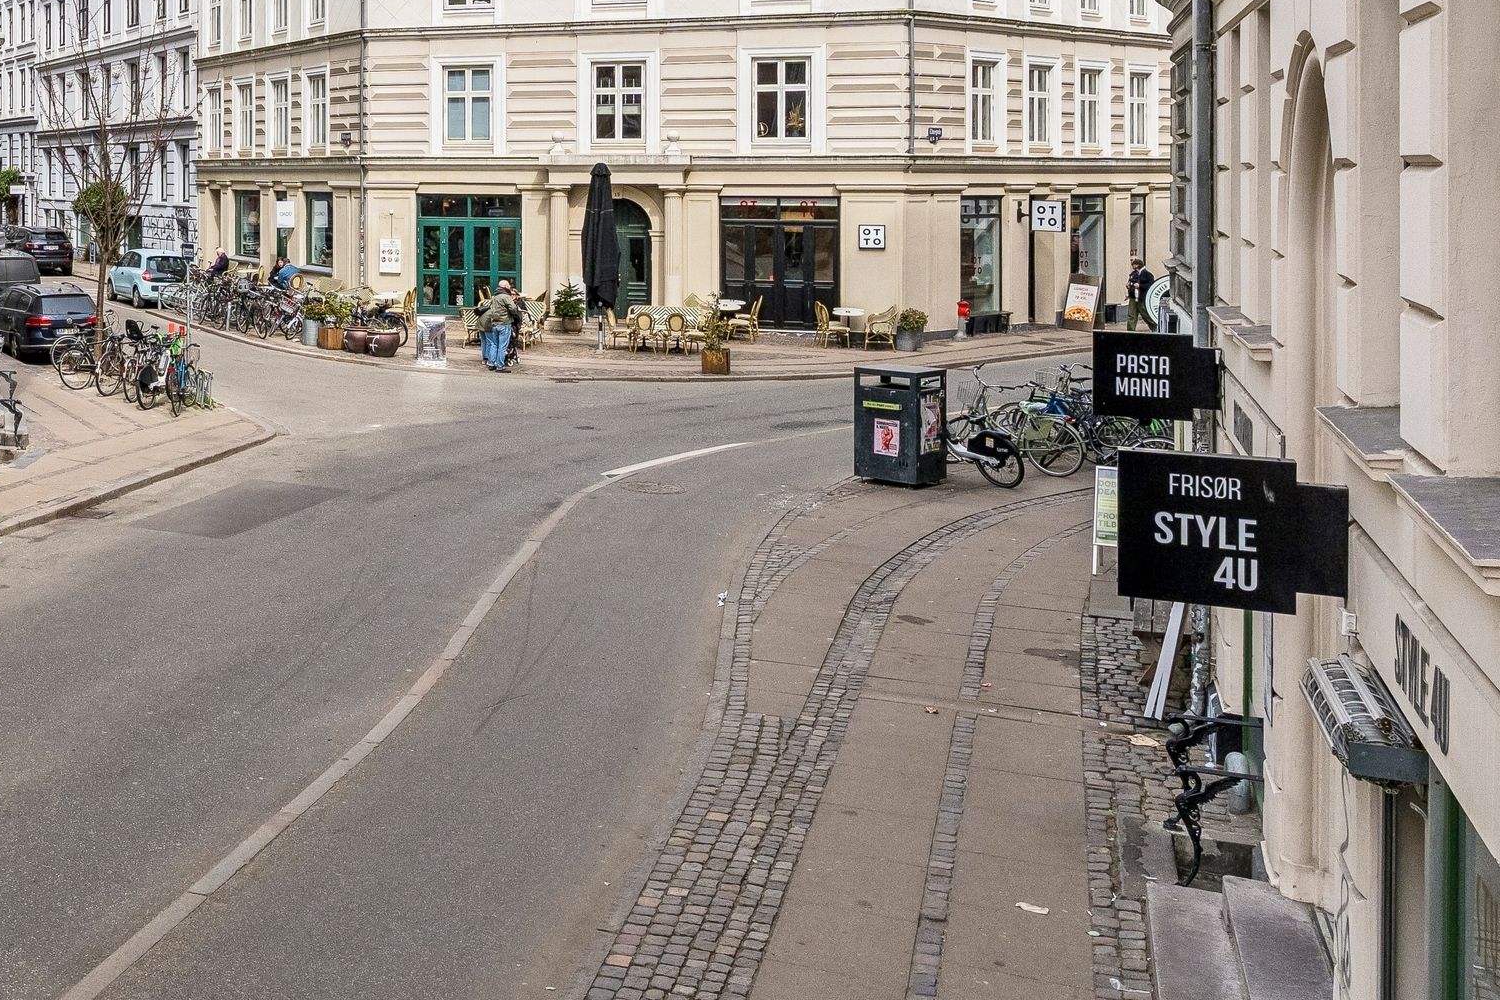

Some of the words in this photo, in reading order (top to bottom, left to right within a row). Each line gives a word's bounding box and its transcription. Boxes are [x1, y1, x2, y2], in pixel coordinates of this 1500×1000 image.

[1037, 205, 1057, 215] OT
[1037, 217, 1057, 226] TO
[863, 228, 881, 236] OT
[1116, 353, 1170, 375] PASTA
[1115, 377, 1170, 398] MANIA
[1099, 480, 1117, 488] DOB
[1168, 473, 1241, 500] FRISØR
[1098, 512, 1117, 520] FRO
[1098, 520, 1117, 528] TILB
[1153, 511, 1258, 552] STYLE
[1213, 556, 1258, 591] 4U
[1394, 613, 1430, 729] STYLE
[1430, 665, 1450, 756] 4U
